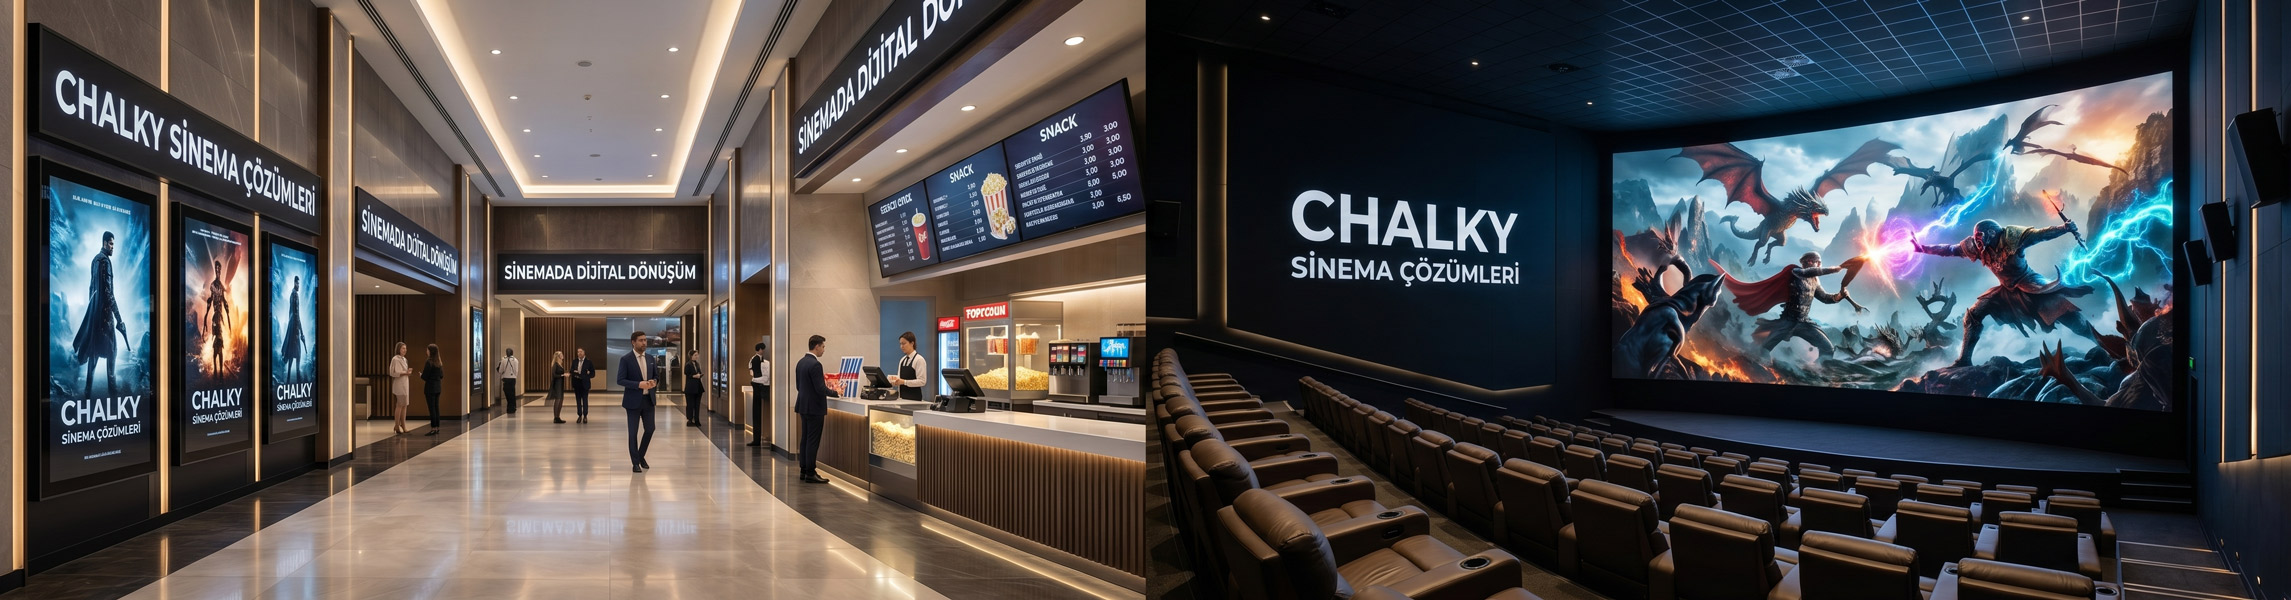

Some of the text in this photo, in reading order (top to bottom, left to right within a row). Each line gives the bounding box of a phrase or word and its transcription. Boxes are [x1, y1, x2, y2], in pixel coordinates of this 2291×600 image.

[798, 78, 855, 154] SİNEMADA
[858, 16, 918, 100] DİJİTAL
[1040, 113, 1078, 142] SNACK
[1103, 121, 1118, 133] 3,00
[56, 70, 316, 216] CHALKY SİNEMA ÇÖZÜMLERİ
[949, 163, 974, 183] SNACK
[1110, 157, 1125, 168] 3,00
[362, 205, 406, 251] SİNEMADA
[1292, 190, 1518, 254] CHALKY
[504, 261, 696, 284] SİNEMADA DİJİTAL DÖNÜŞÜM
[1291, 251, 1520, 287] SİNEMA ÇÖZÜMLERİ
[192, 388, 242, 410] CHALKY
[276, 382, 313, 401] CHALKY
[61, 395, 141, 426] CHALKY
[192, 413, 214, 425] SİNEMA
[61, 421, 141, 445] SİNEMA ÇÖZÜMLERİ
